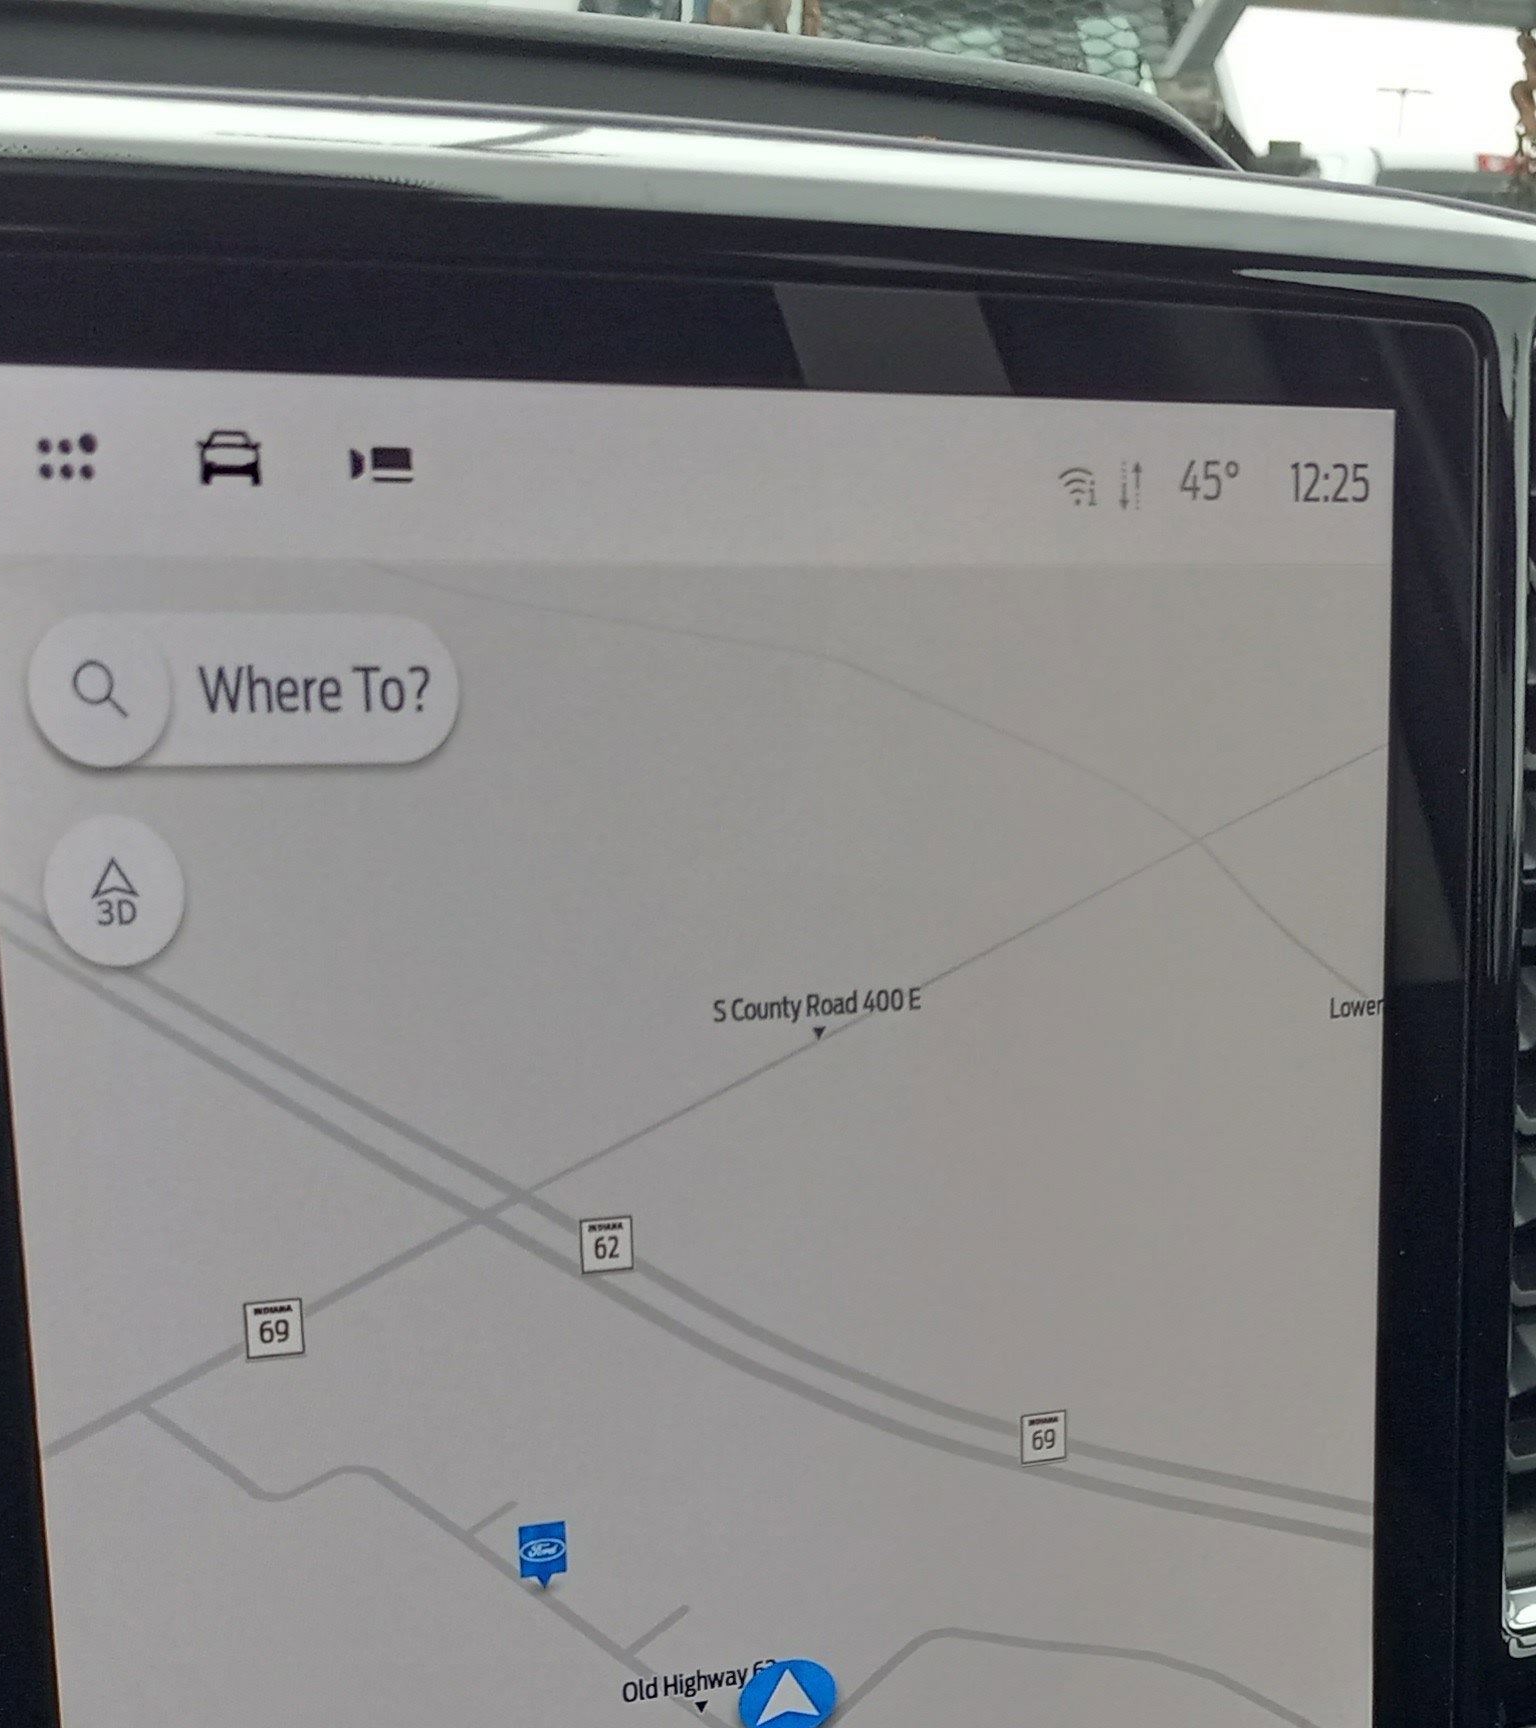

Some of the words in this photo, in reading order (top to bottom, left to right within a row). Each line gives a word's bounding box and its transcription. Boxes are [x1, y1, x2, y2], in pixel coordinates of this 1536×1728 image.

[1180, 460, 1240, 500] 45°
[1291, 462, 1369, 503] 12:25
[198, 665, 342, 713] Where
[353, 665, 431, 713] To?
[96, 901, 138, 926] 3D
[714, 999, 726, 1022] S
[731, 996, 802, 1023] County
[806, 989, 858, 1018] Road
[863, 988, 904, 1013] 400
[909, 987, 921, 1010] E
[594, 1235, 620, 1260] 62
[259, 1319, 289, 1344] 69
[1032, 1429, 1056, 1451] 69
[622, 1677, 659, 1702] Old
[663, 1668, 749, 1698] Highway
